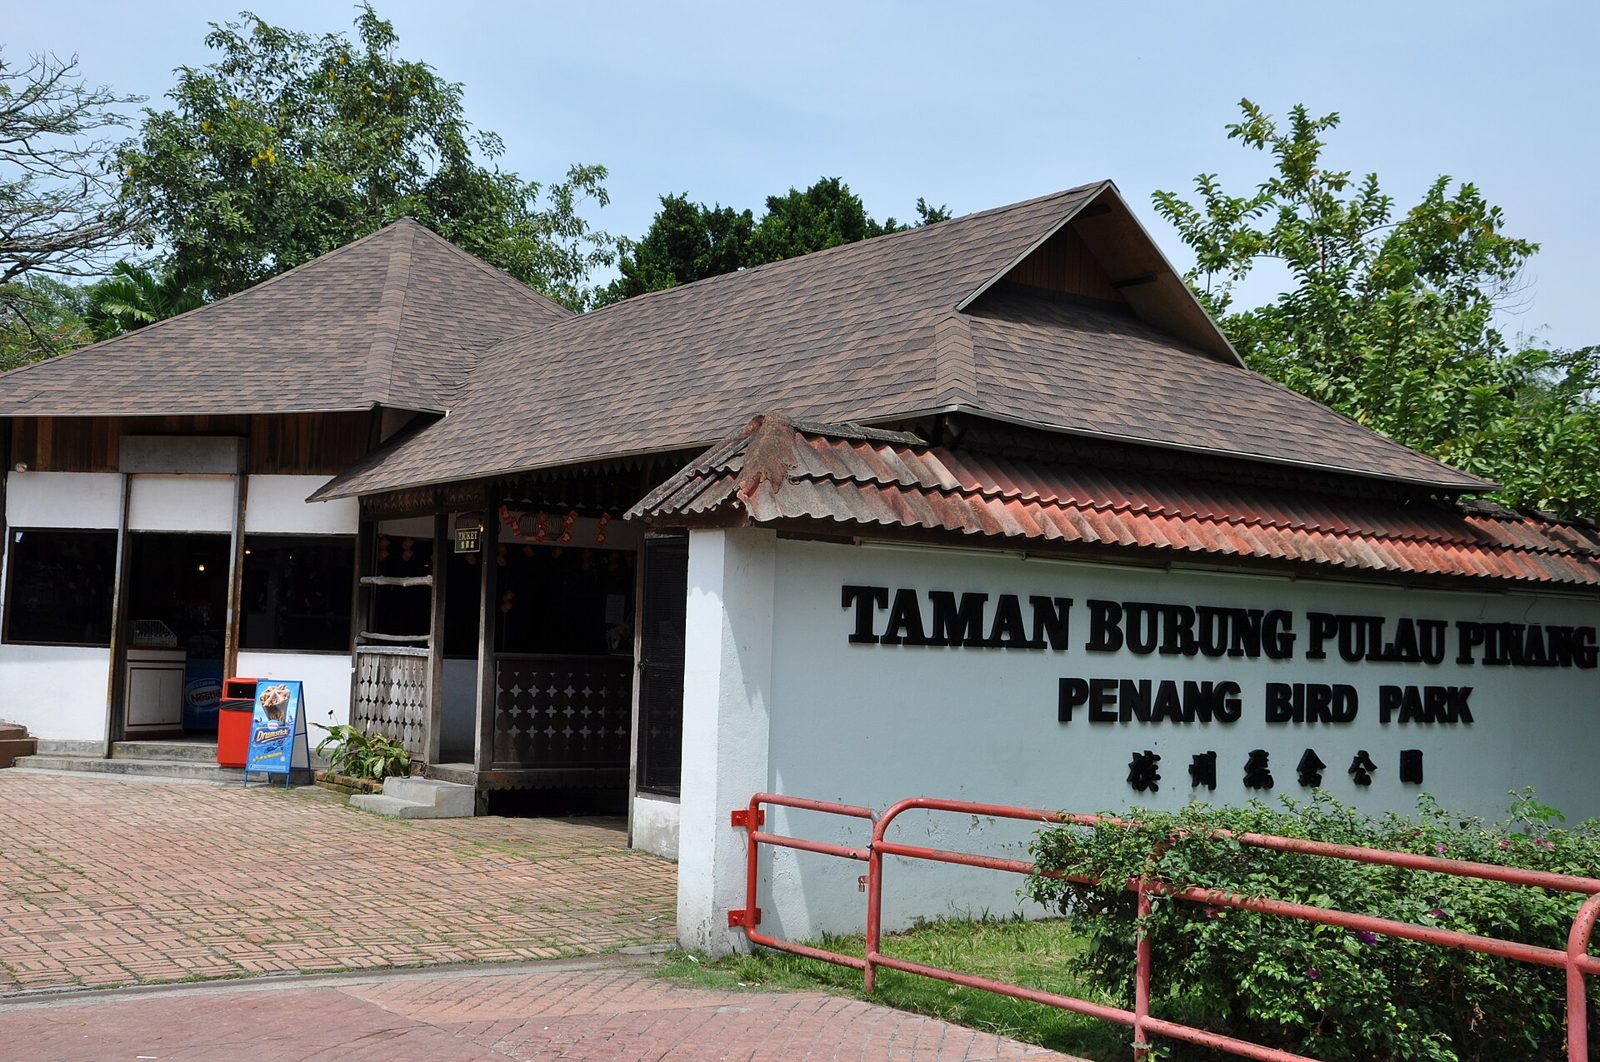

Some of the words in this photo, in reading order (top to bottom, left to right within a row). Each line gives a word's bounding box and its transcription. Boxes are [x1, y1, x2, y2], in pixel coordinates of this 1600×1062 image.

[842, 585, 1074, 651] TAMAN
[1086, 599, 1297, 660] BURUNG
[1305, 612, 1448, 665] PULAU
[1456, 621, 1600, 670] PINANG
[1058, 678, 1242, 723] PENANG
[1265, 683, 1359, 724] BIRD
[1379, 685, 1475, 724] PARK
